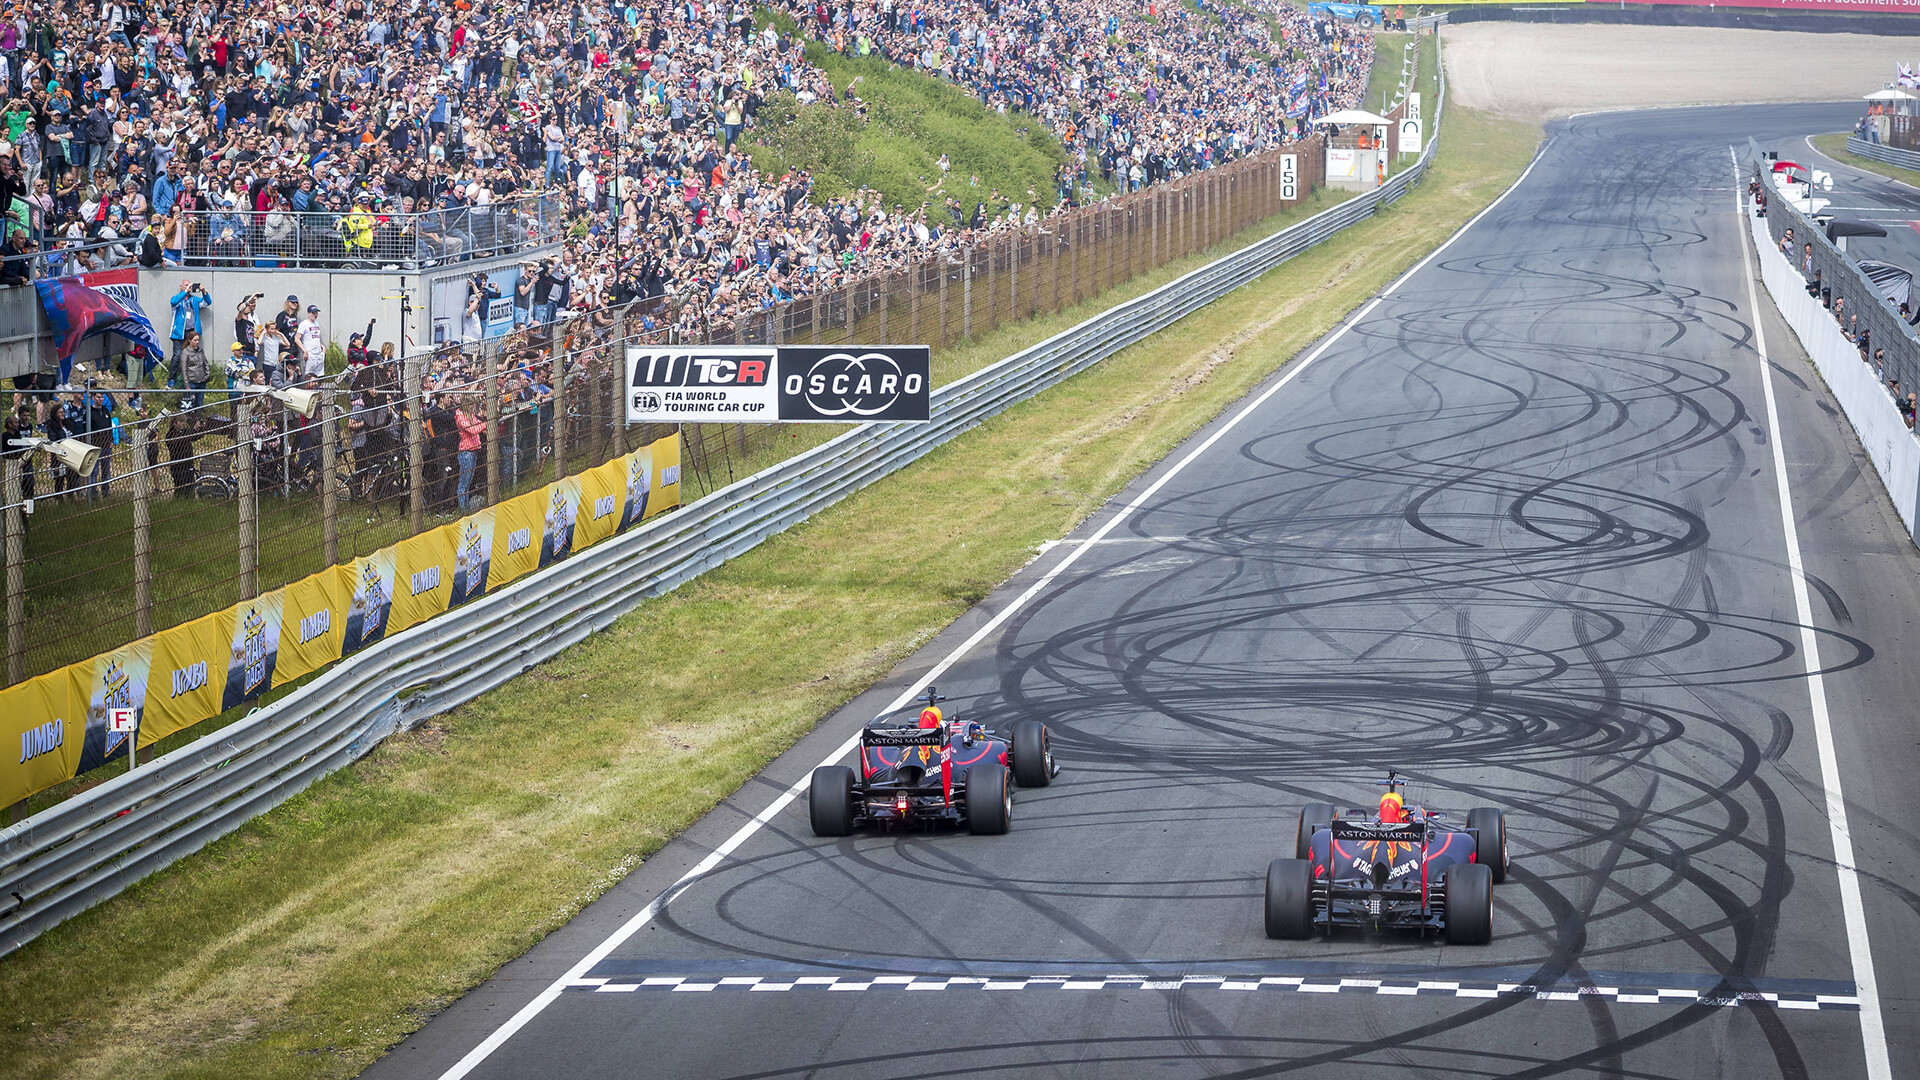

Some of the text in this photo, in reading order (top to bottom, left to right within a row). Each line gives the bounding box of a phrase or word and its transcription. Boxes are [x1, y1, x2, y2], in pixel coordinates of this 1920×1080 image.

[1283, 157, 1295, 198] 150
[632, 355, 774, 387] WTCR
[785, 373, 922, 395] OSCARO
[664, 403, 765, 412] TOURING CAR CUP
[665, 391, 727, 401] FIA WORLD
[660, 463, 679, 488] JUMBO
[594, 494, 615, 521] JUMBO
[507, 526, 530, 555] JUMBO
[411, 565, 440, 597] JUMBO
[300, 608, 331, 645] JUMBO
[171, 660, 208, 699] JUMBO
[115, 711, 128, 729] F
[19, 718, 63, 765] JUMBO
[1338, 830, 1421, 840] ASTON MARTIN
[1358, 860, 1371, 875] TAG
